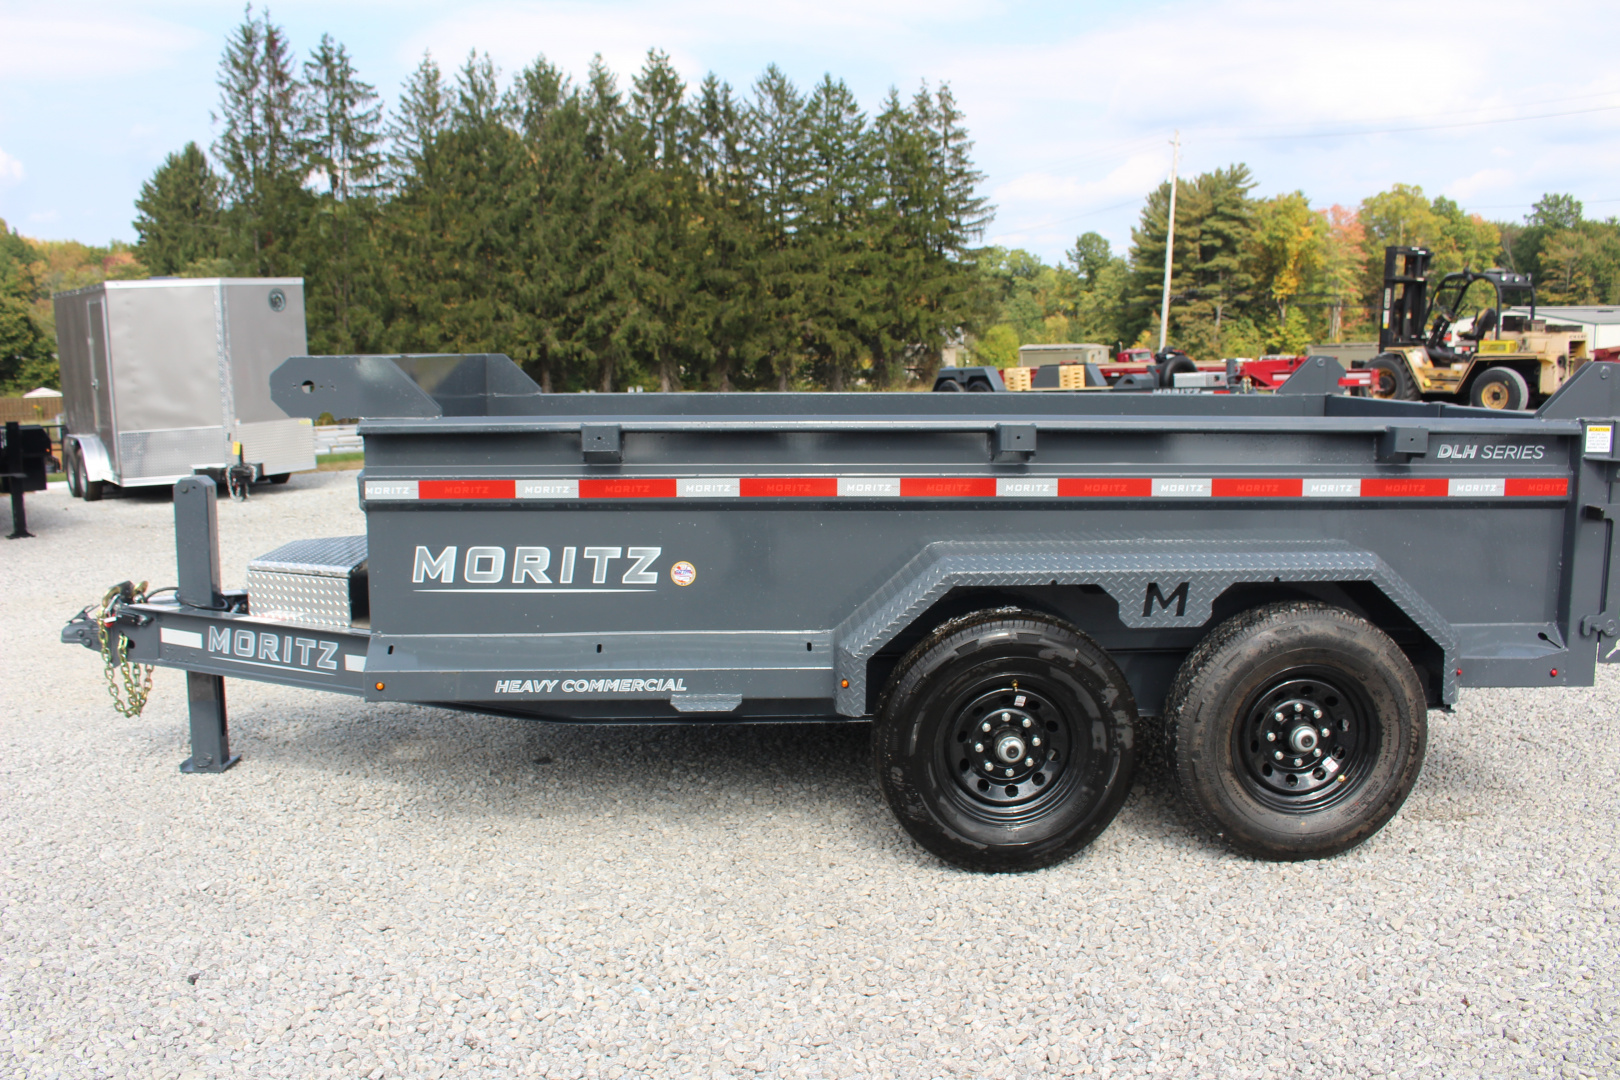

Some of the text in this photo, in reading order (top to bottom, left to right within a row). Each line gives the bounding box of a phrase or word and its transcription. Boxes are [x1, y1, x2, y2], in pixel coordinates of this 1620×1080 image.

[1437, 444, 1545, 460] DLH SERIES
[365, 483, 1568, 495] MORITZ MORITZ MORITZ MORITZ MORITZ MORITZ MORITZ MORITZ MORITZ MORITZ MORITZ MORITZ MORITZ MORITZ MORITZ MORITZ
[412, 546, 662, 584] MORITZ
[1142, 582, 1190, 617] M
[208, 625, 339, 670] MORITZ
[494, 678, 687, 693] HEAVY COMMERCIAL
